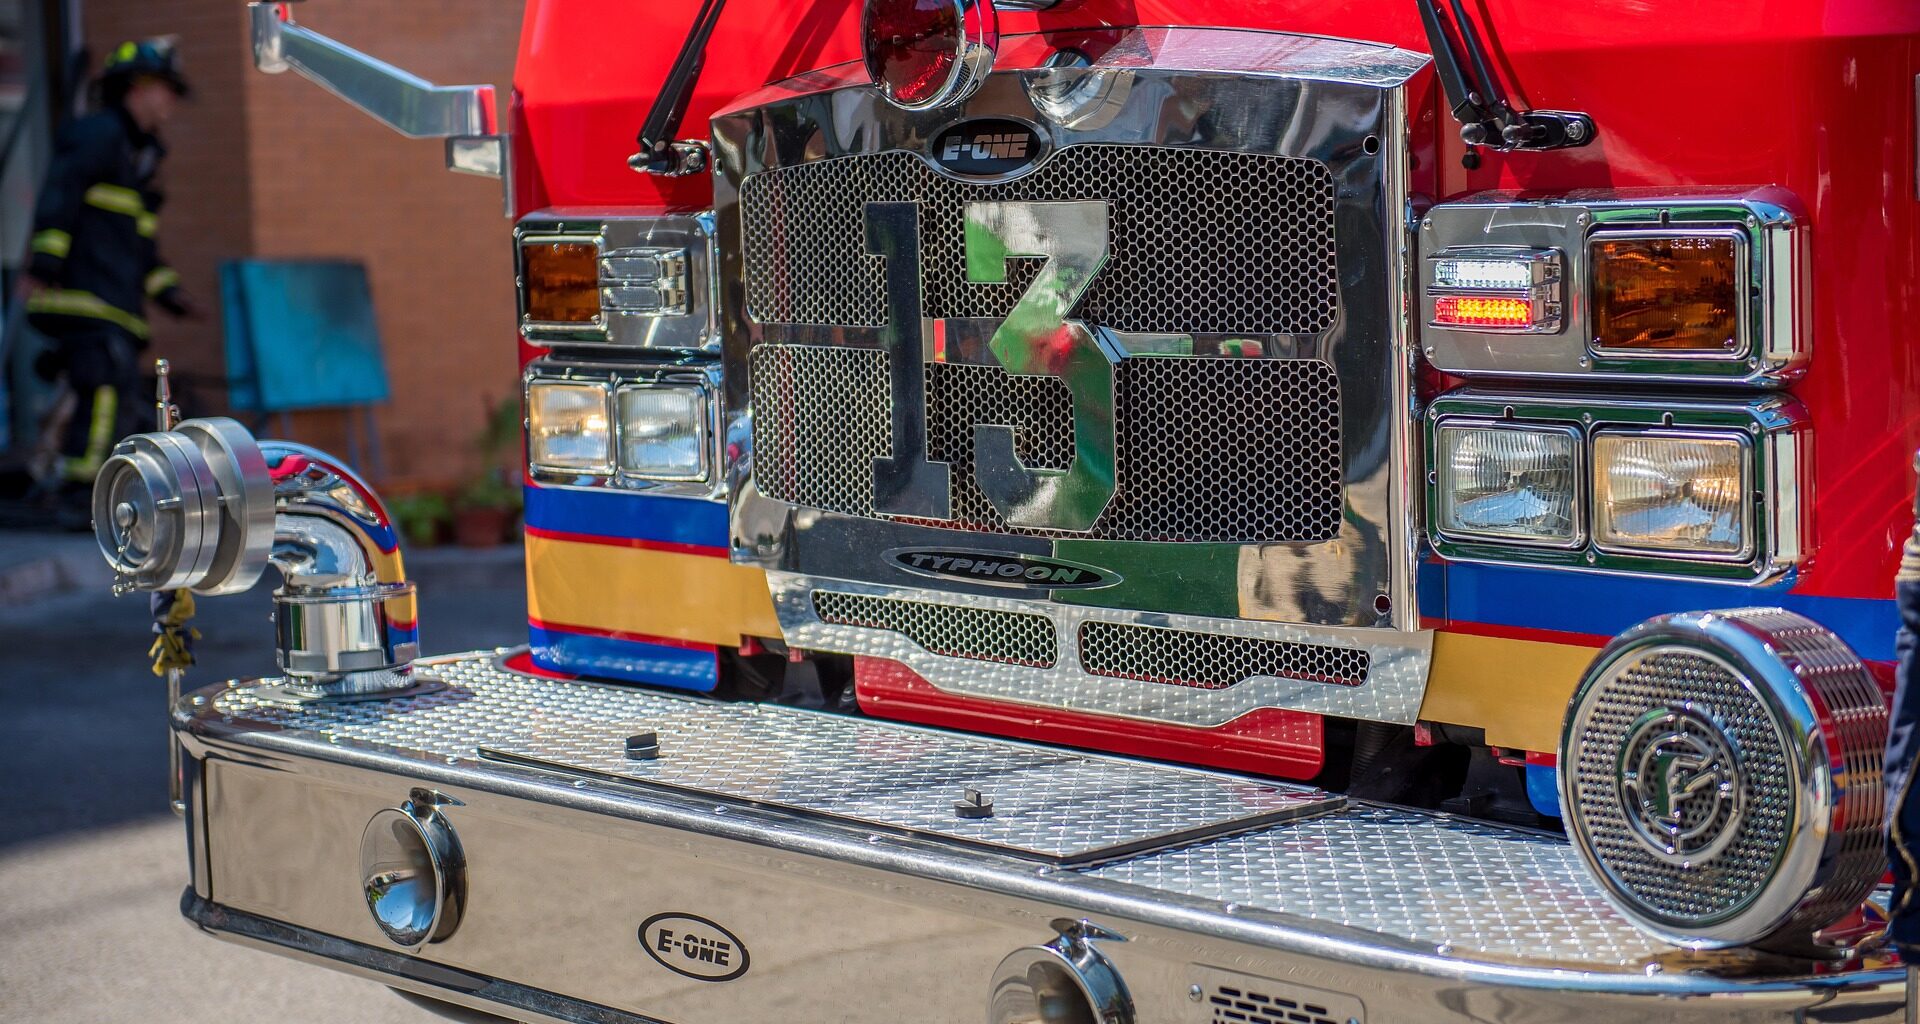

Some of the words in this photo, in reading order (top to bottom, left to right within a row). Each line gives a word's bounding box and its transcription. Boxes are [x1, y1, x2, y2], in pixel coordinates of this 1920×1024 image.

[942, 133, 1030, 161] E-ONE
[864, 200, 1117, 532] 13
[910, 553, 1082, 583] TYPHOON
[657, 928, 731, 967] E-ONE
